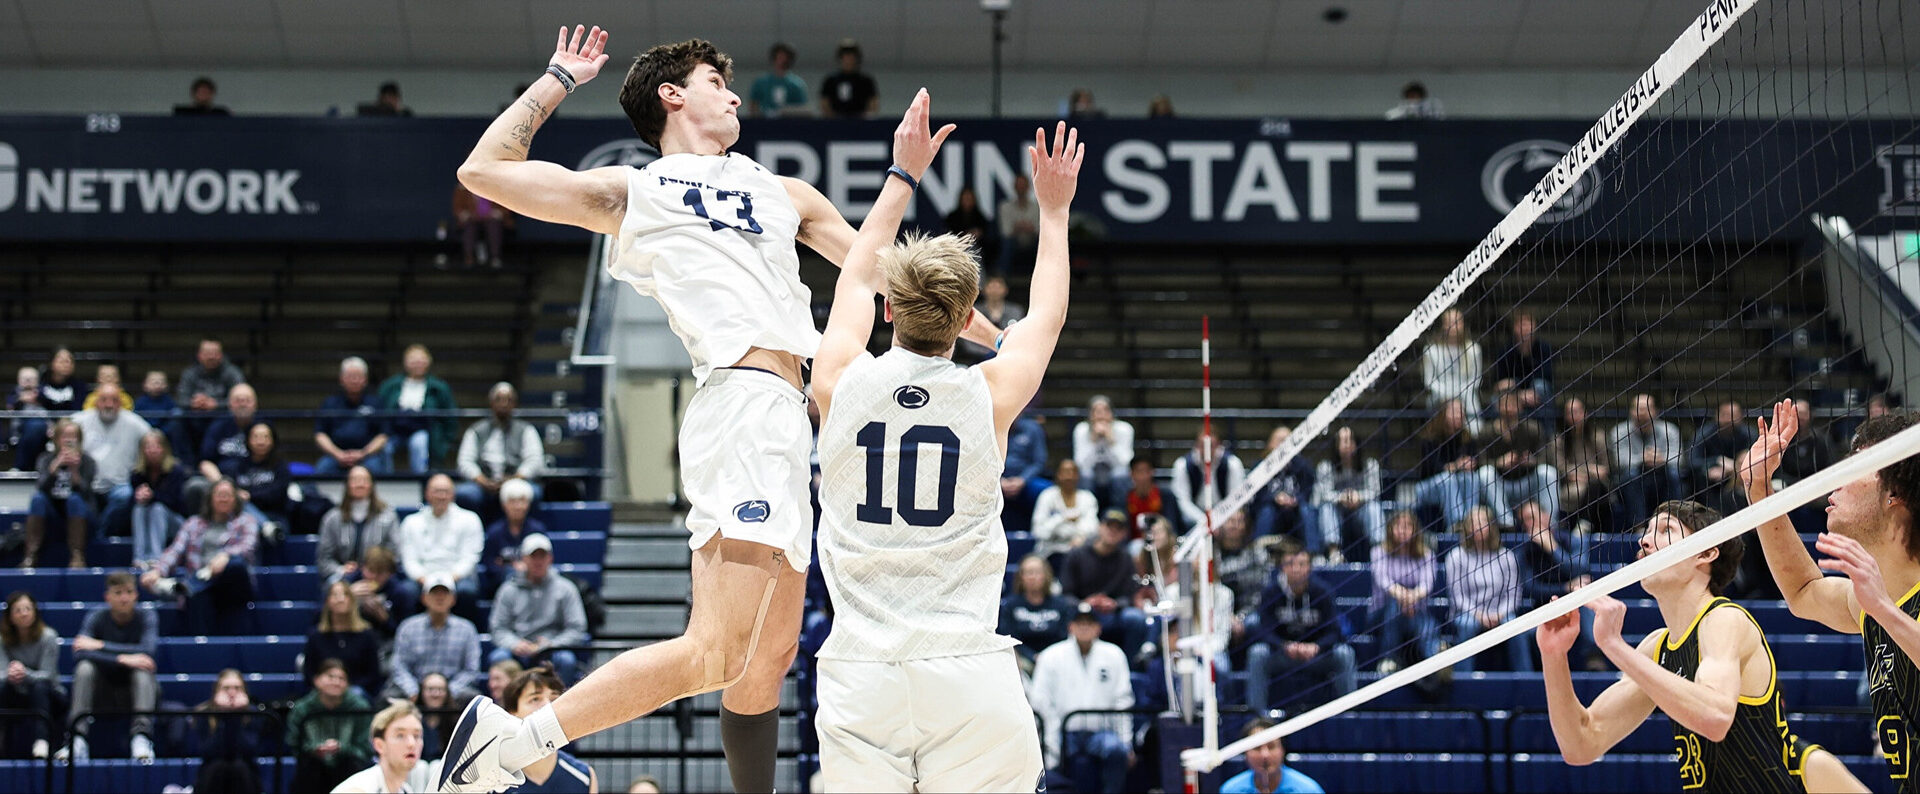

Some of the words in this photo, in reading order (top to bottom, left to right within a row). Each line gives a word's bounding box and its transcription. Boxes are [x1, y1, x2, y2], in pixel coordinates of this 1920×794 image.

[1588, 66, 1660, 153] VOLLEYBALL
[25, 168, 301, 214] NETWORK
[682, 188, 764, 234] 13
[1102, 139, 1421, 223] STATE
[856, 421, 961, 527] 10
[1877, 714, 1911, 780] 9
